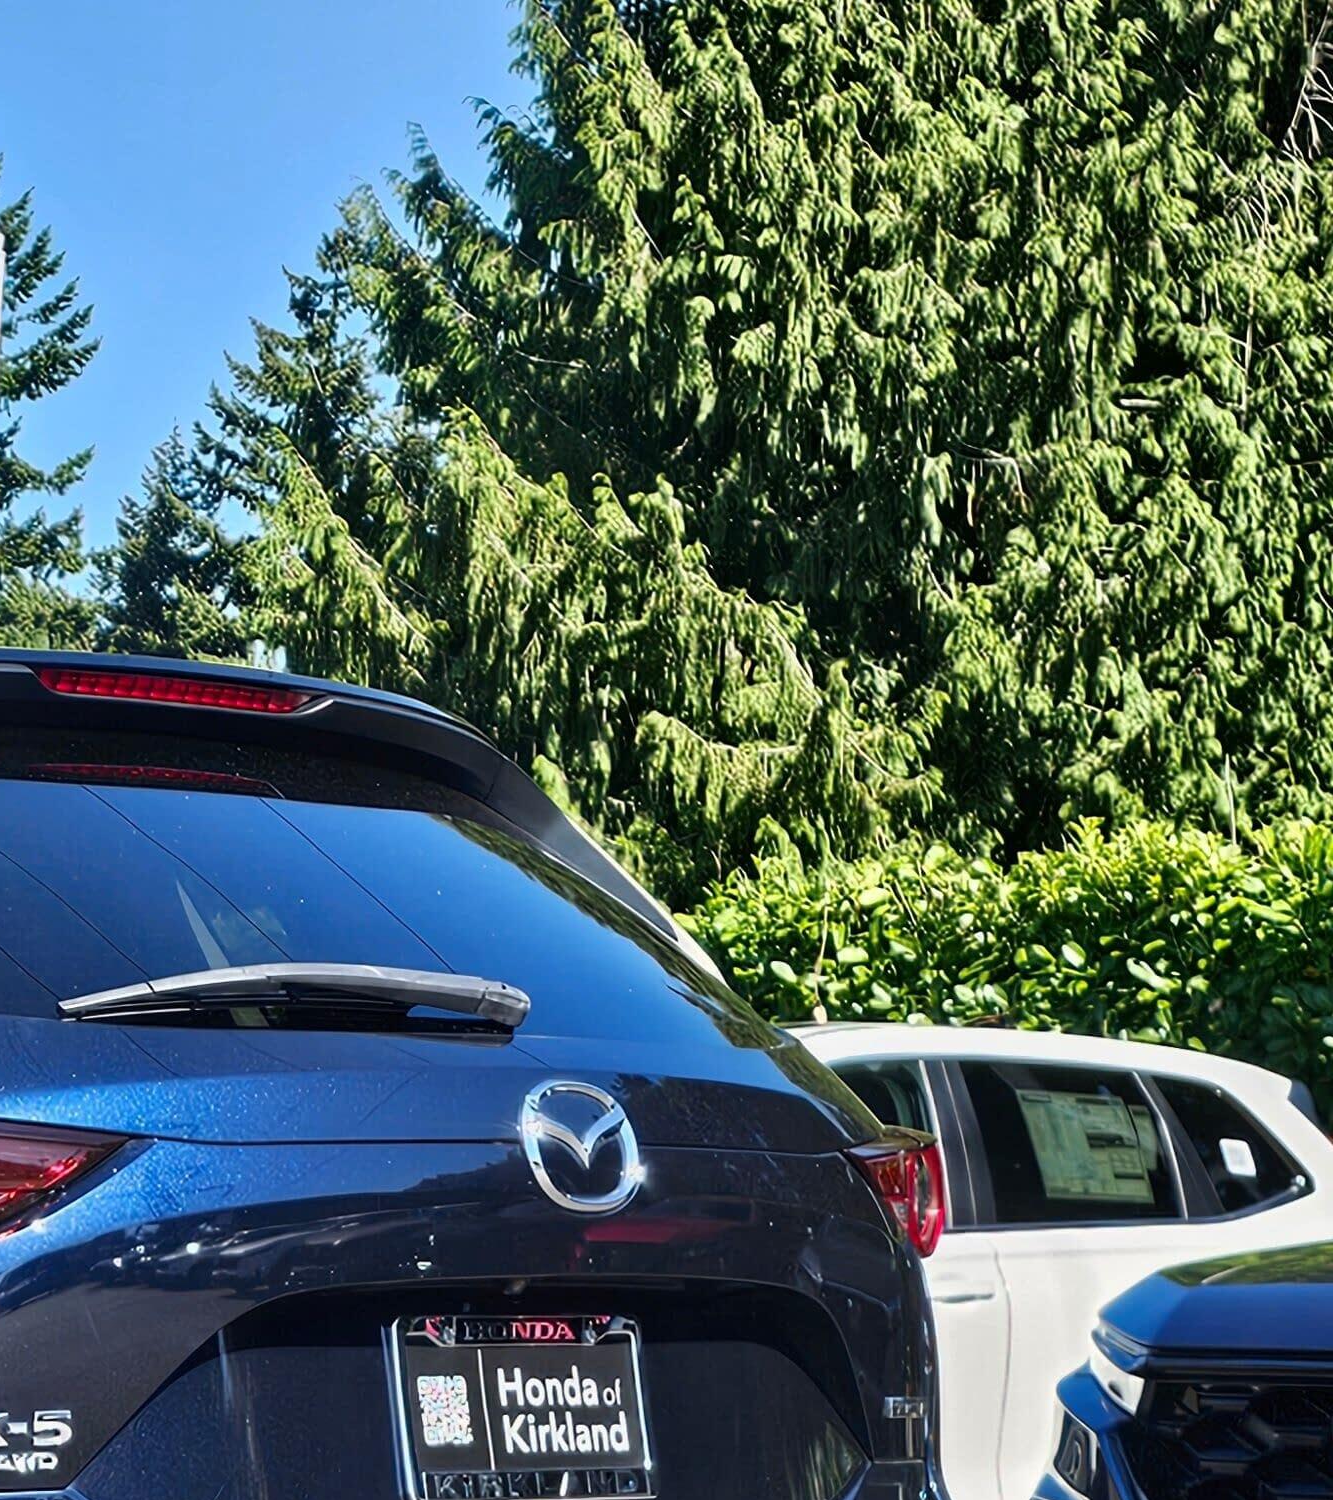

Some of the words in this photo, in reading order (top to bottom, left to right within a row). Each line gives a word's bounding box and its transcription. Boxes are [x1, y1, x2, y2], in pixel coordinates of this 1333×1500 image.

[464, 1321, 575, 1341] HONDA
[497, 1365, 598, 1407] Honda
[602, 1378, 622, 1406] of
[502, 1411, 631, 1454] Kirkland
